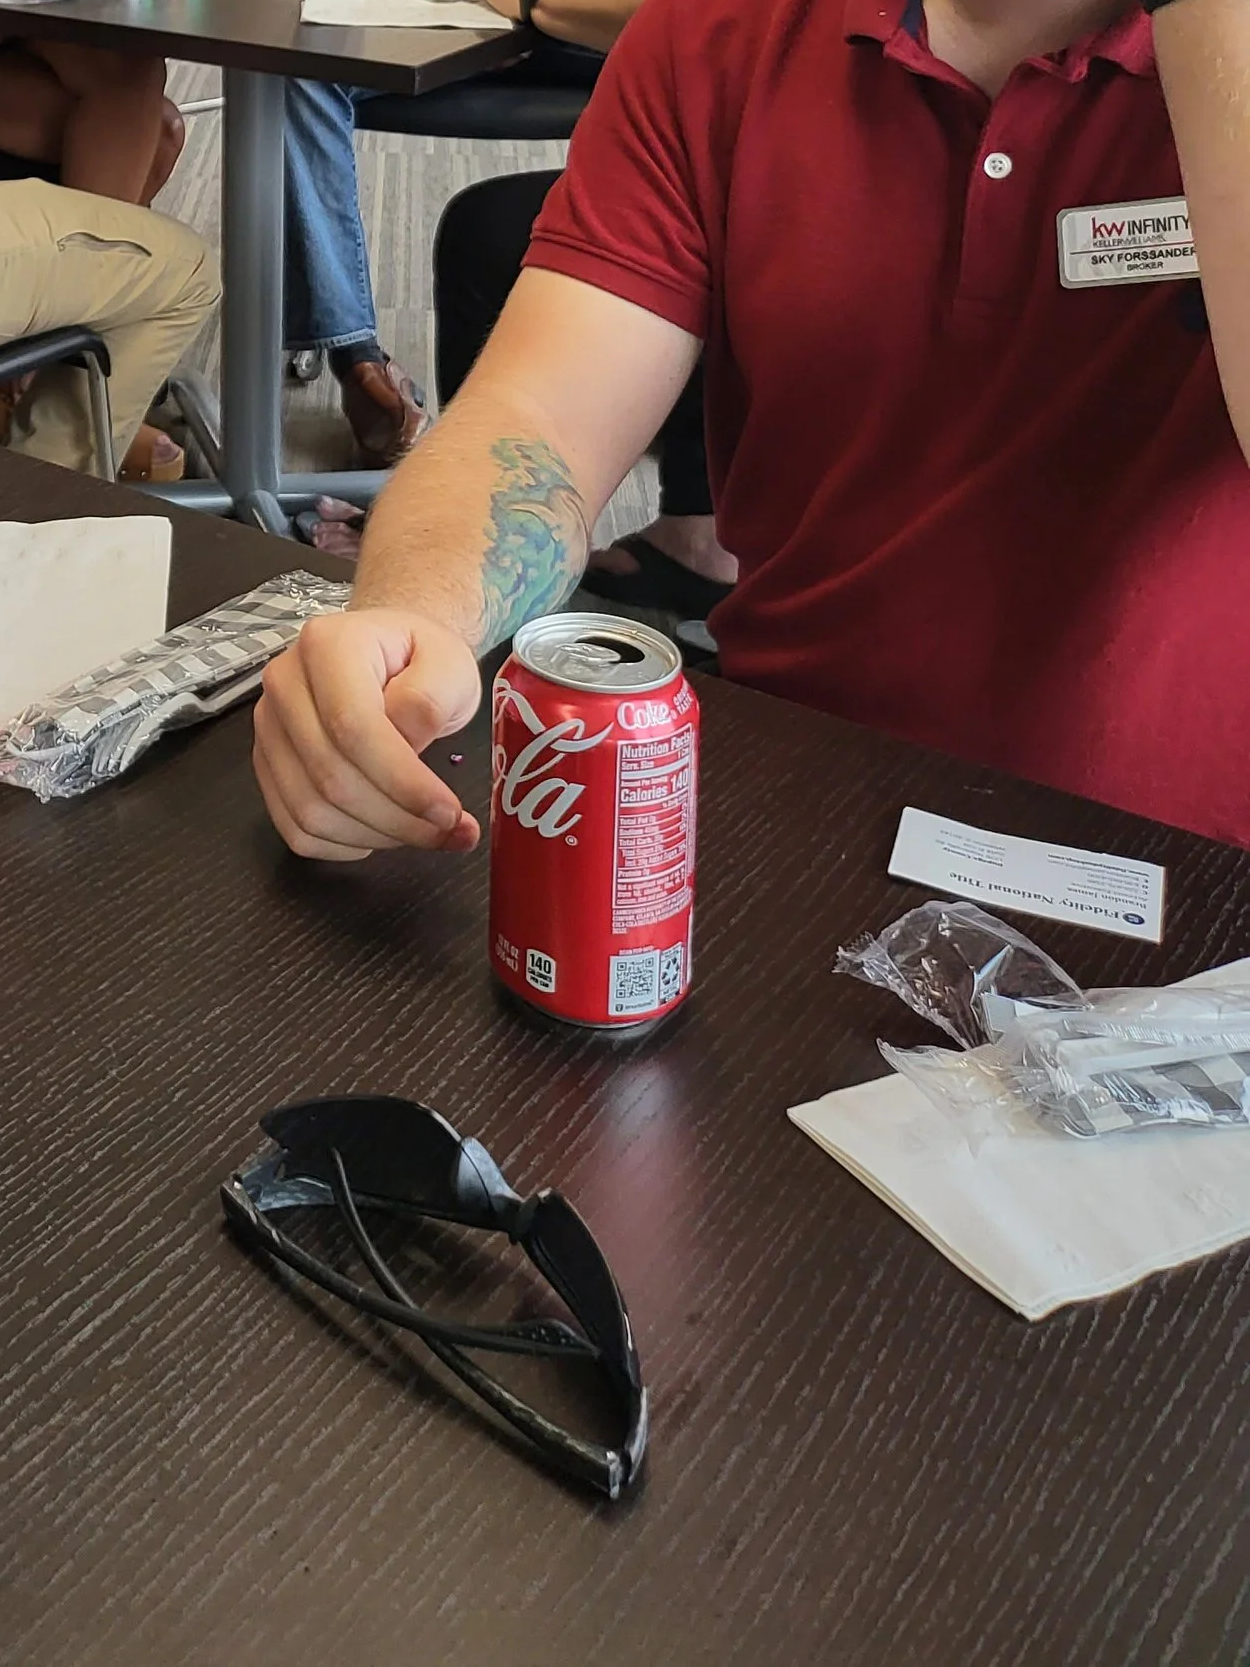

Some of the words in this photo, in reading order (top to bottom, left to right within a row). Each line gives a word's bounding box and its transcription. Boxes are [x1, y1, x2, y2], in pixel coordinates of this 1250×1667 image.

[1091, 254, 1114, 265] SKY
[1127, 262, 1164, 271] BROKER
[617, 700, 671, 730] Coke
[622, 742, 669, 759] Nutrition
[671, 732, 690, 751] Facts
[620, 786, 668, 803] Calories
[671, 768, 690, 793] 140
[949, 871, 984, 889] Title
[987, 881, 1054, 904] National
[1066, 885, 1098, 900] James
[1101, 893, 1147, 909] Brandon
[1059, 897, 1120, 919] Fidelity
[530, 953, 552, 974] 140
